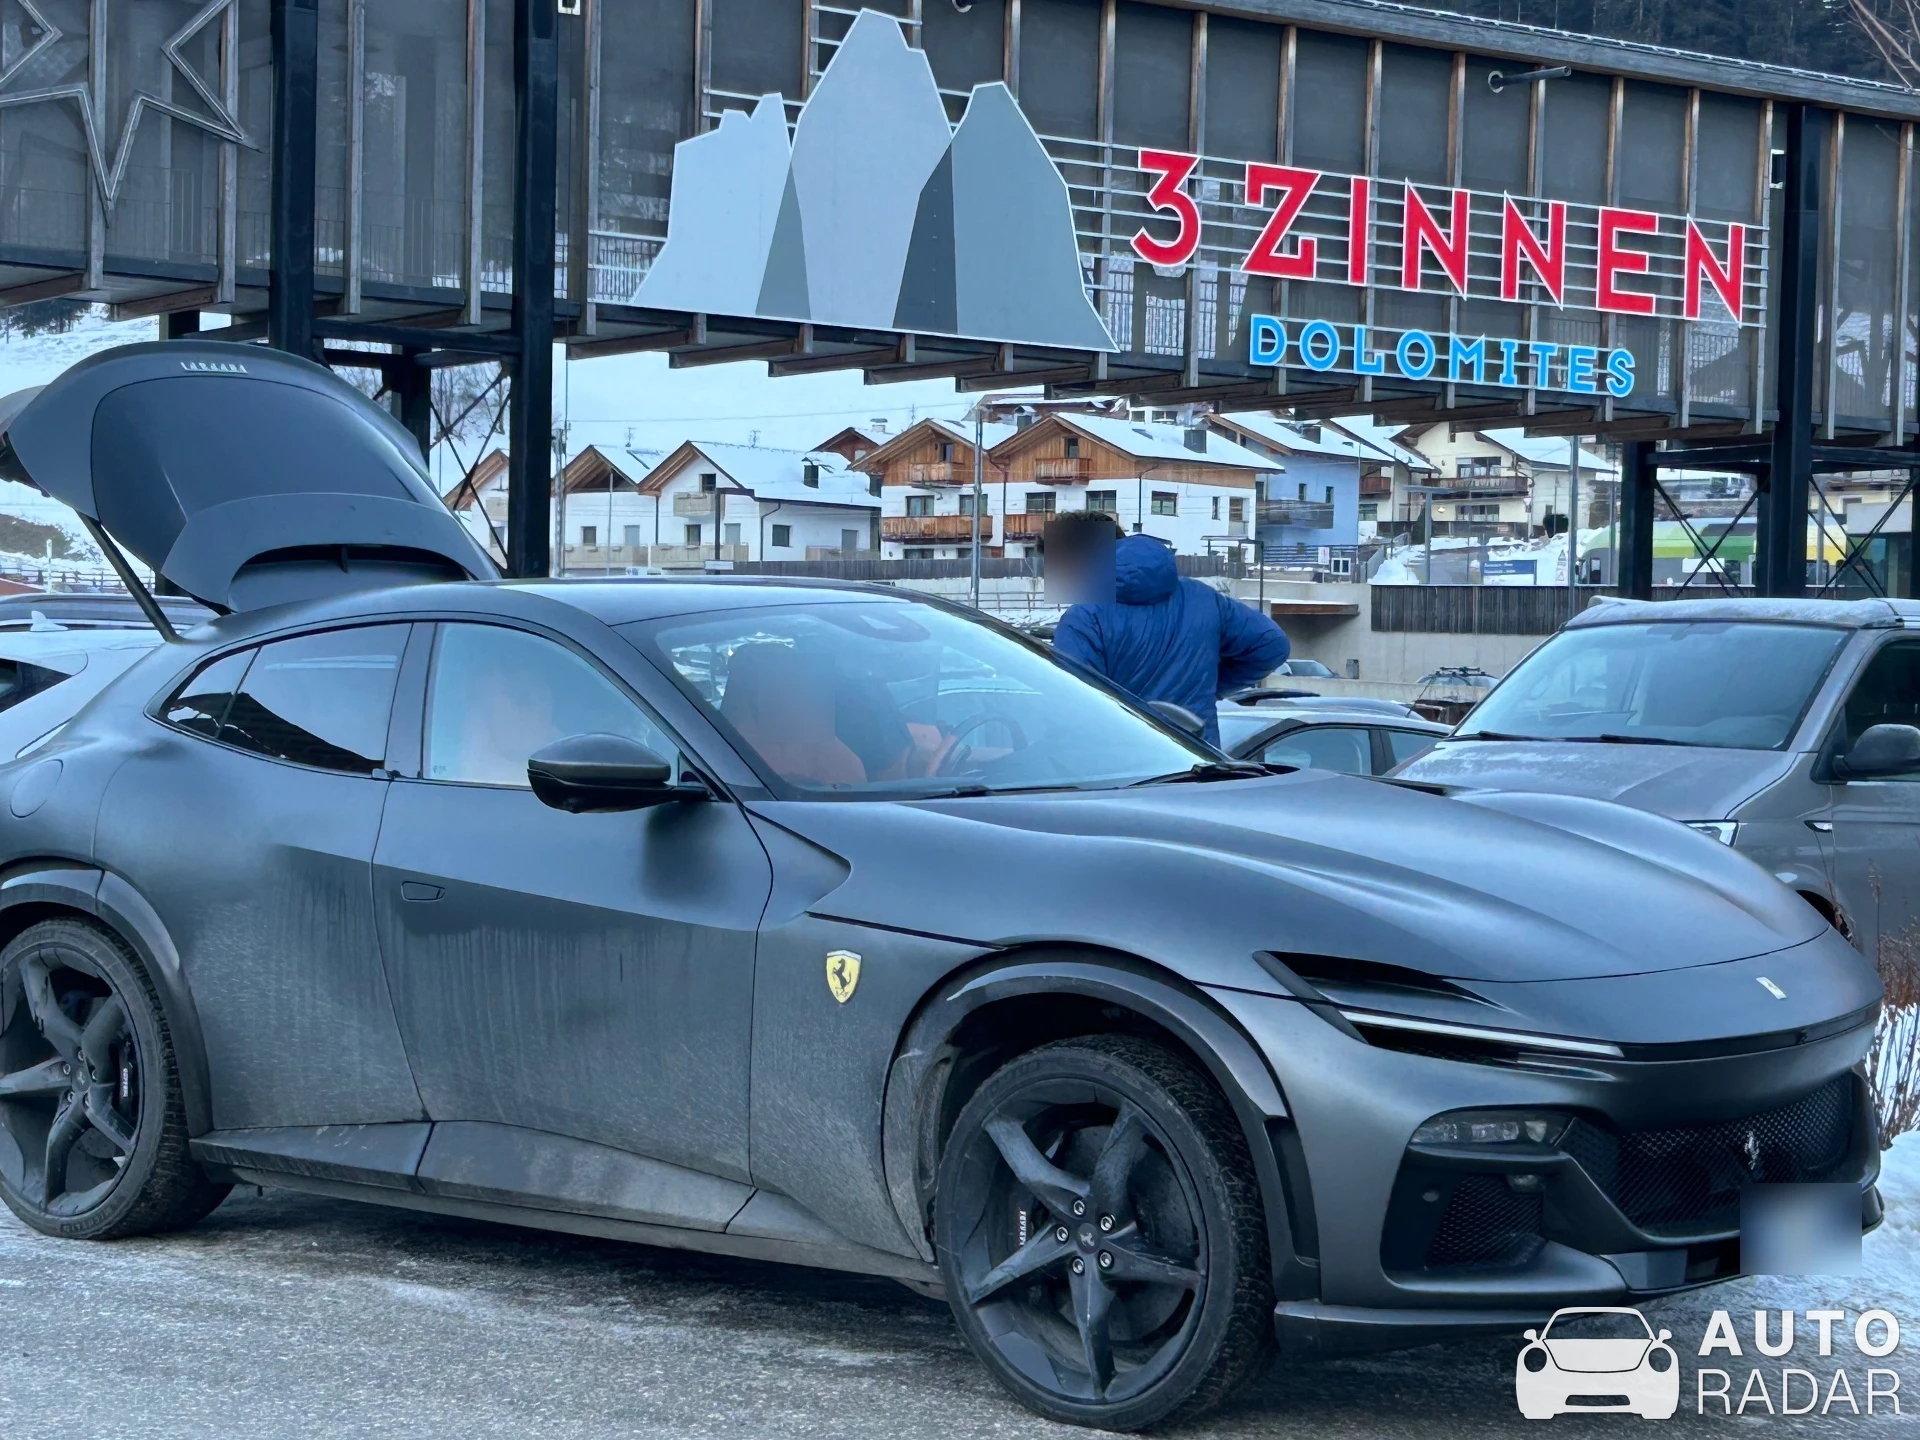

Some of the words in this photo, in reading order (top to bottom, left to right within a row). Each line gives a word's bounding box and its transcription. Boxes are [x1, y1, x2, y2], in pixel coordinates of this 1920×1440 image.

[1129, 146, 1202, 268] 3
[1241, 161, 1745, 329] ZINNEN
[1249, 313, 1636, 398] DOLOMITES
